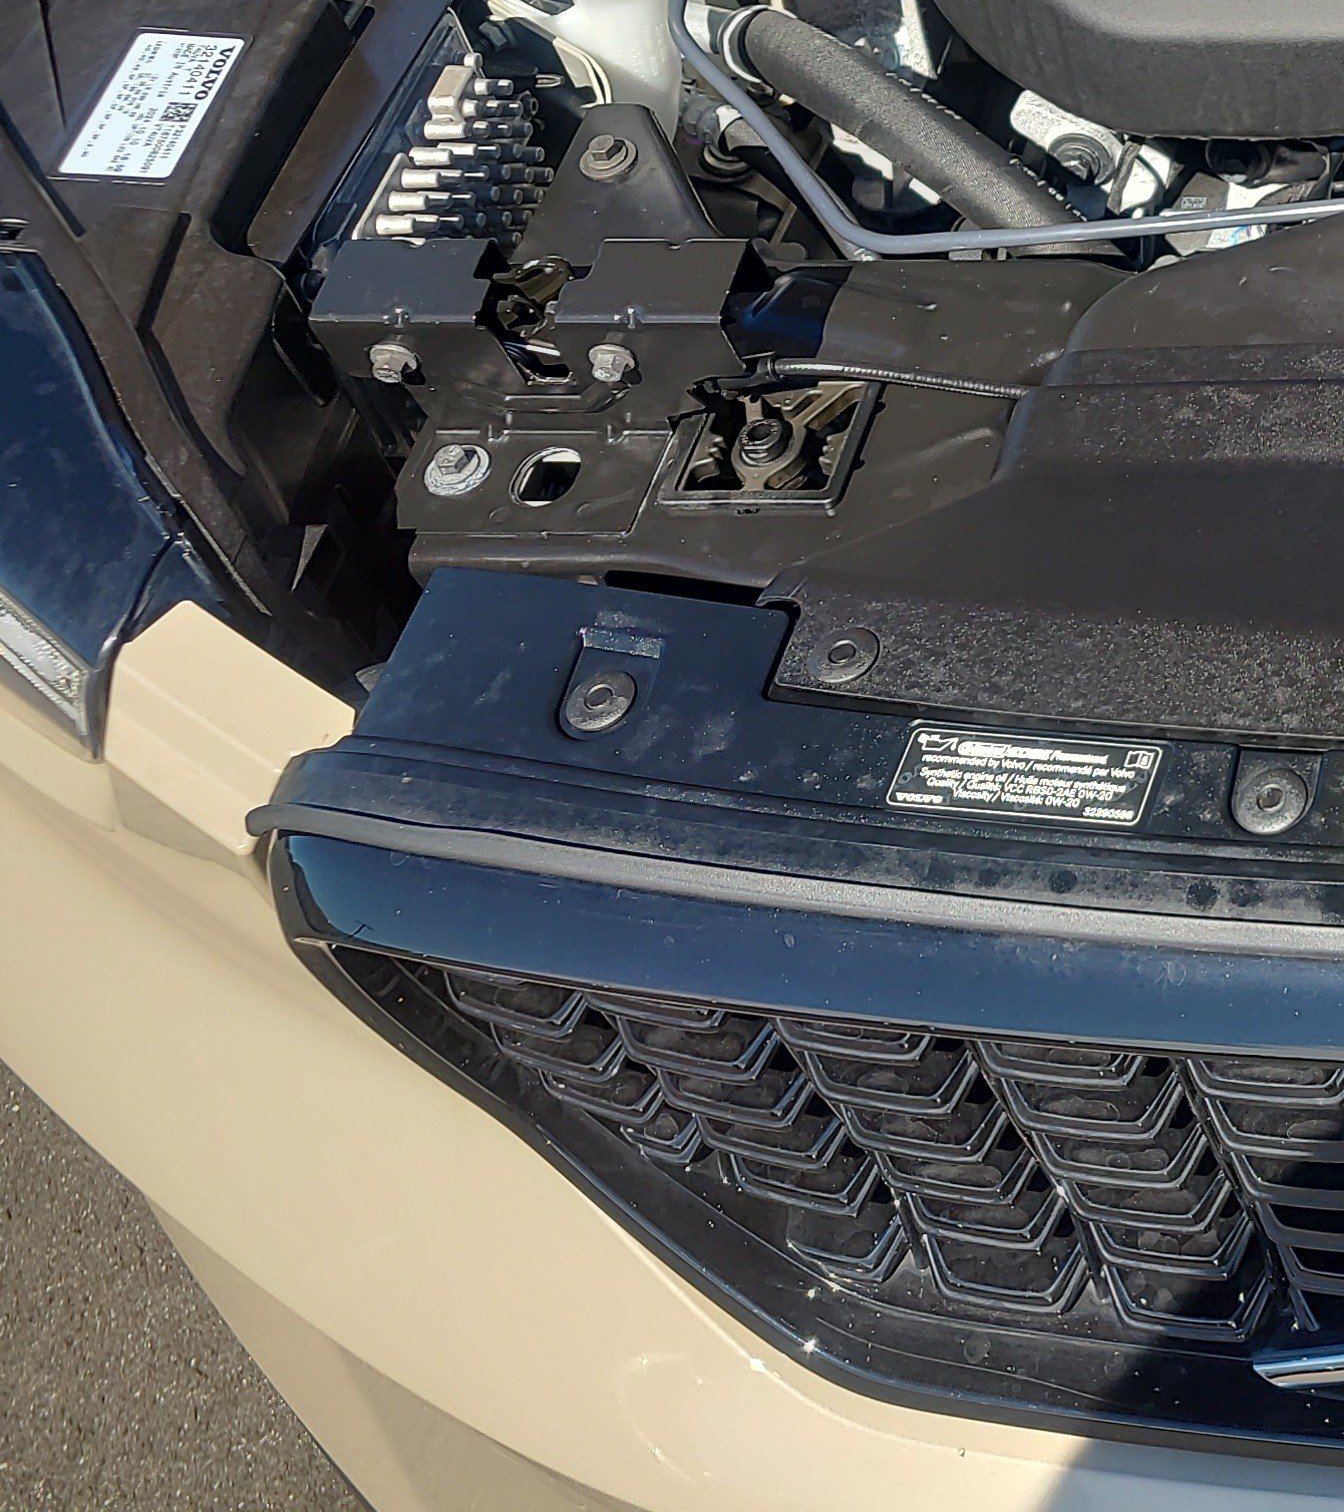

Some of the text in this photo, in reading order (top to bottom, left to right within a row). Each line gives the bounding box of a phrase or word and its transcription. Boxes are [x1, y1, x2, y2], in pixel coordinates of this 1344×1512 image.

[178, 44, 218, 95] 32140411
[192, 45, 235, 100] VOLVO
[1001, 759, 1026, 770] Volvo
[1110, 768, 1136, 779] Volvo
[895, 792, 943, 804] VOLVO
